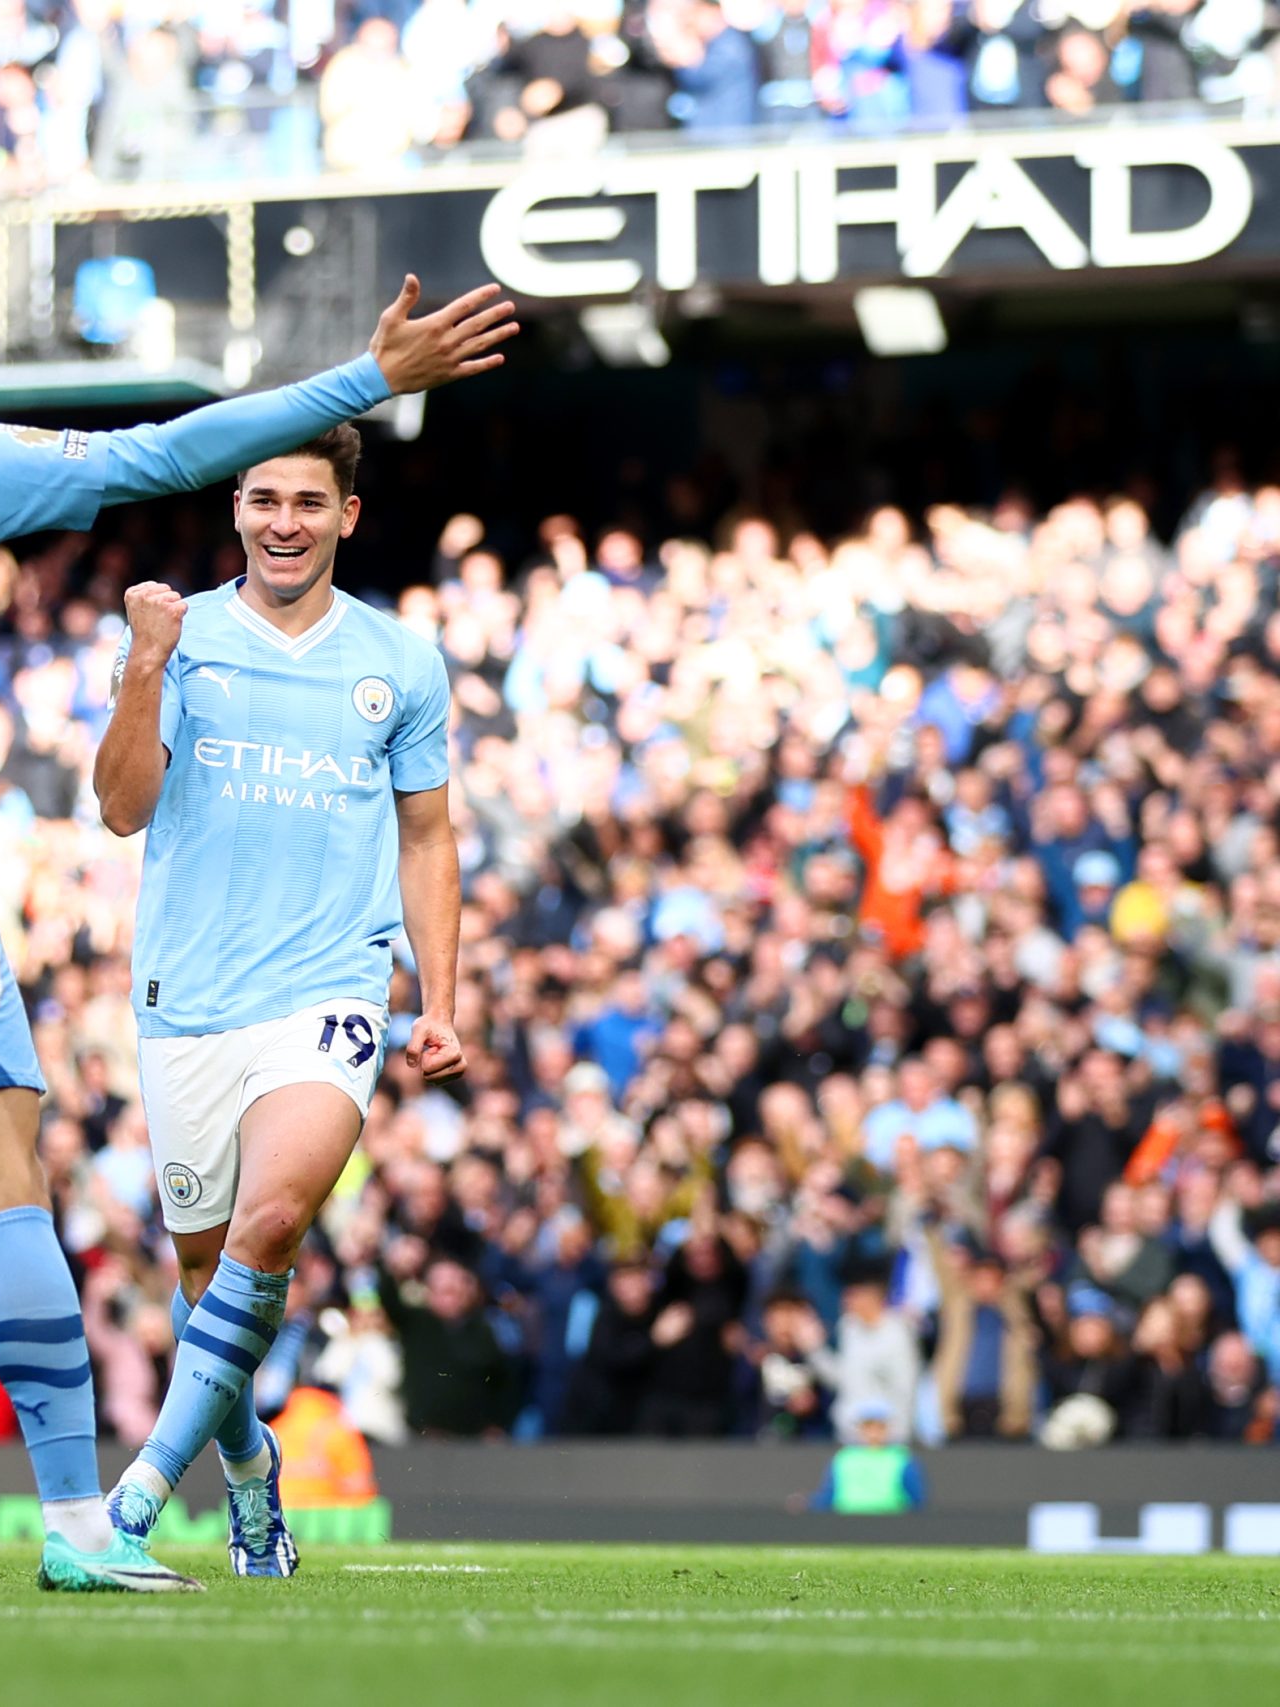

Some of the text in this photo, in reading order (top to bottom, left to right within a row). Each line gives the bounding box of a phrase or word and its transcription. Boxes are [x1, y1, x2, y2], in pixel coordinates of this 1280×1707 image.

[479, 138, 1254, 298] ETIHAD
[194, 737, 372, 787] ETIHAD
[221, 780, 348, 813] AIRWAYS
[317, 1013, 377, 1068] 19
[192, 1370, 237, 1401] CITY
